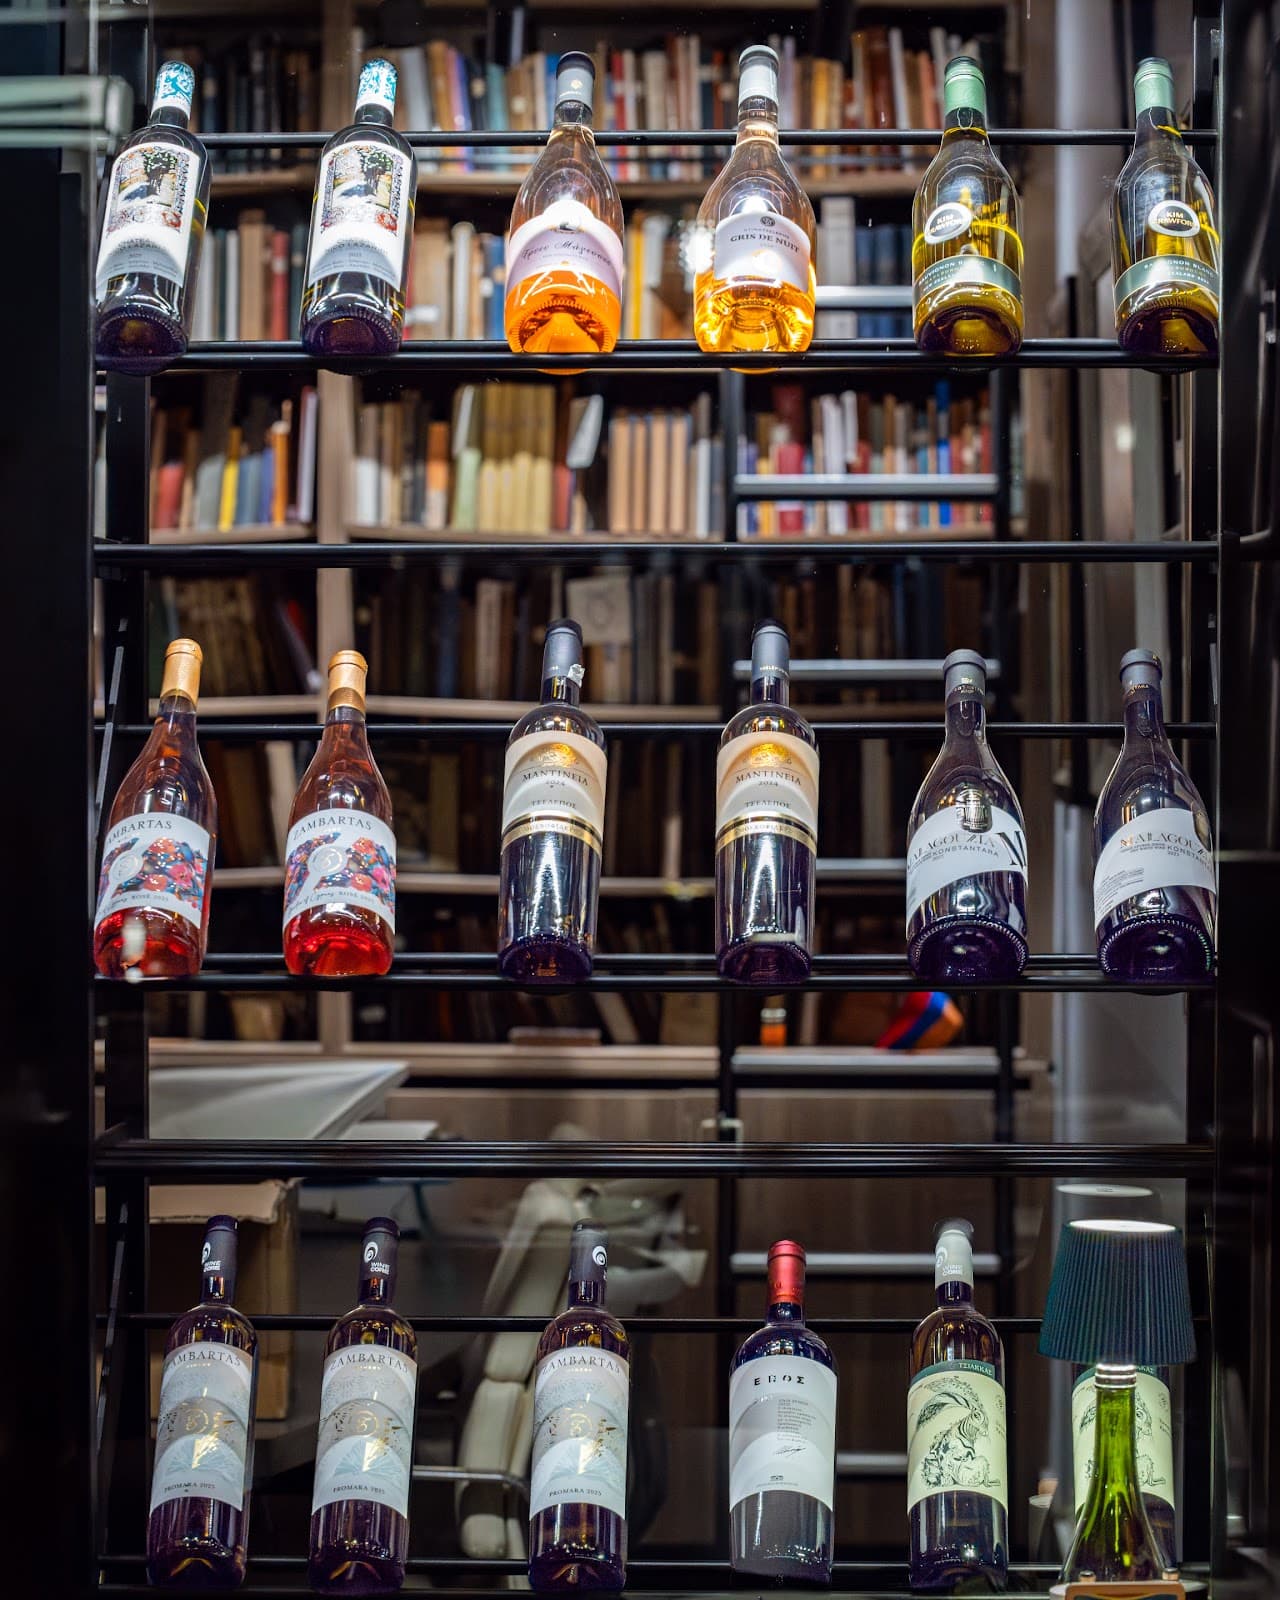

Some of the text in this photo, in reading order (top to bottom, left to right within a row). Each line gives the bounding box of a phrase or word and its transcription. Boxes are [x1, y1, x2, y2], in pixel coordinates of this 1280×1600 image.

[937, 214, 954, 225] KIM
[730, 233, 756, 242] GRIS
[760, 233, 774, 241] DE
[775, 237, 800, 253] NUIT
[107, 820, 172, 844] AMBARTAS
[294, 816, 372, 840] ZAMBARTAS
[931, 843, 999, 859] KONSTANTARA
[371, 1261, 390, 1269] WINE
[330, 1352, 408, 1374] ZAMBARTAS
[542, 1354, 620, 1376] ZAMBARTAS
[958, 1362, 993, 1376] ΤΣΙΑΚΚΑΣ
[549, 1488, 585, 1498] PROMARA
